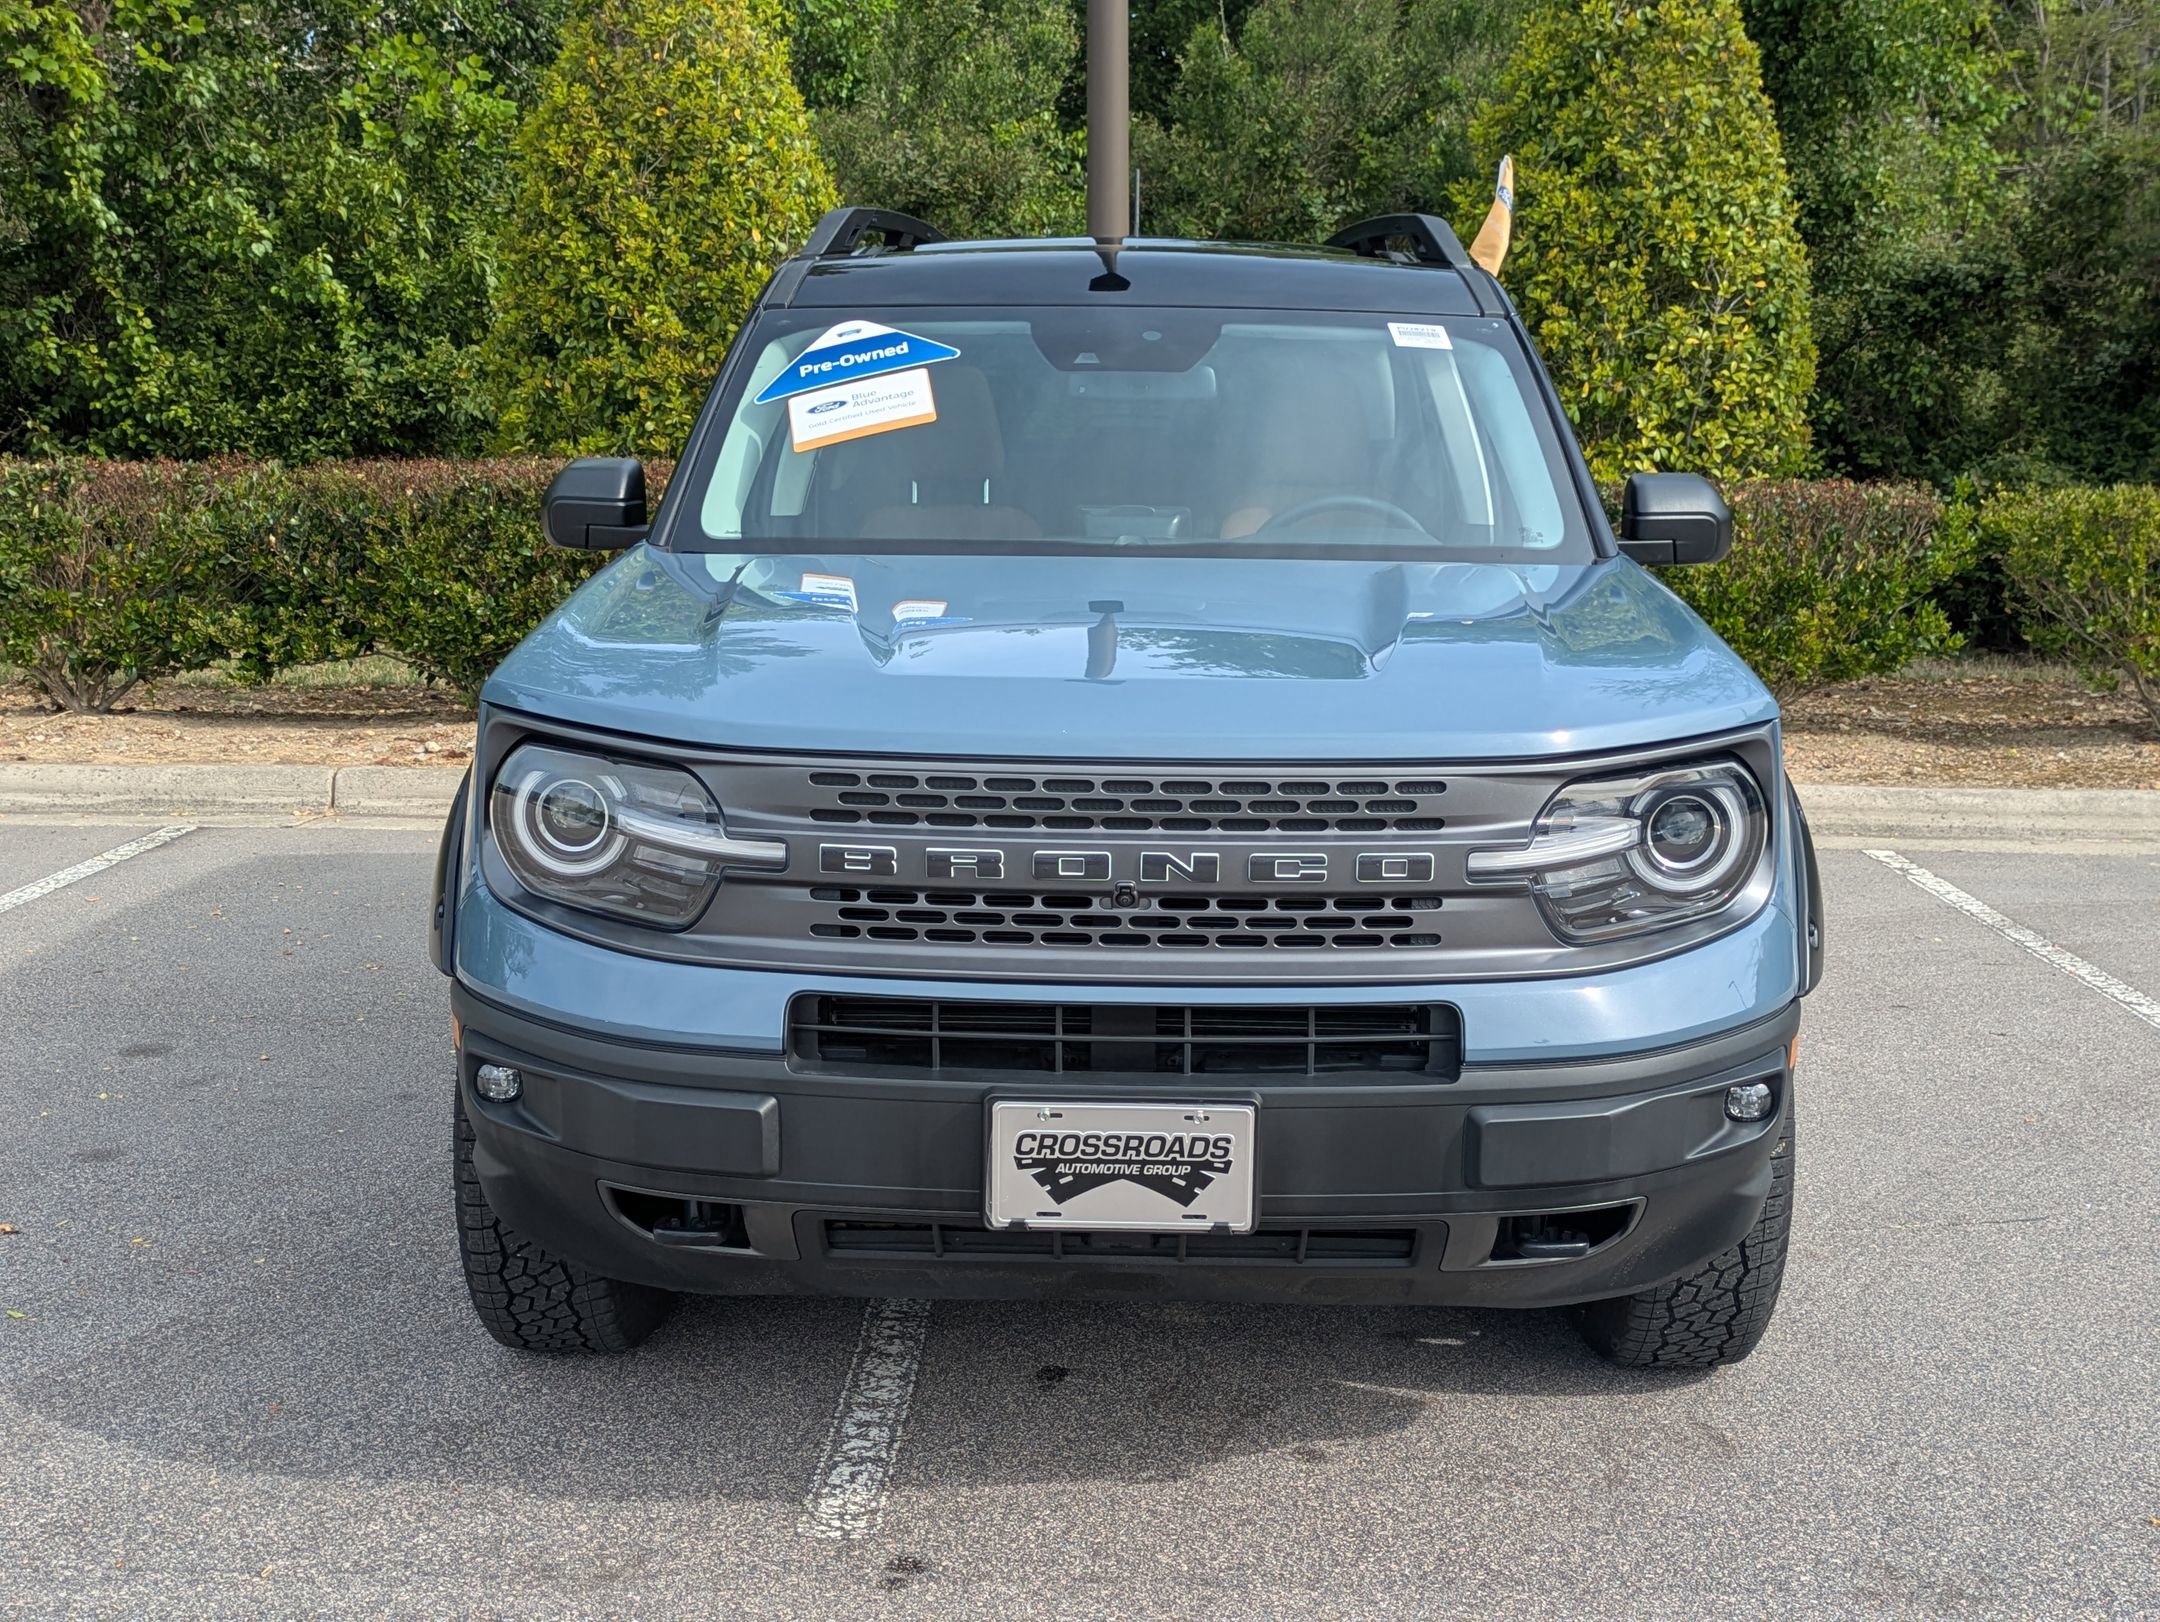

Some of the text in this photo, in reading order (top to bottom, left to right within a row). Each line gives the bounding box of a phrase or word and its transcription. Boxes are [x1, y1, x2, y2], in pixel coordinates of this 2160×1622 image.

[800, 341, 909, 377] Pre-Owned
[851, 390, 877, 400] Blue
[852, 390, 914, 407] Advantage
[819, 843, 1434, 882] BRONCO
[1016, 1134, 1231, 1160] CROSSROADS
[1055, 1162, 1192, 1176] AUTOMOTIVE GROUP
